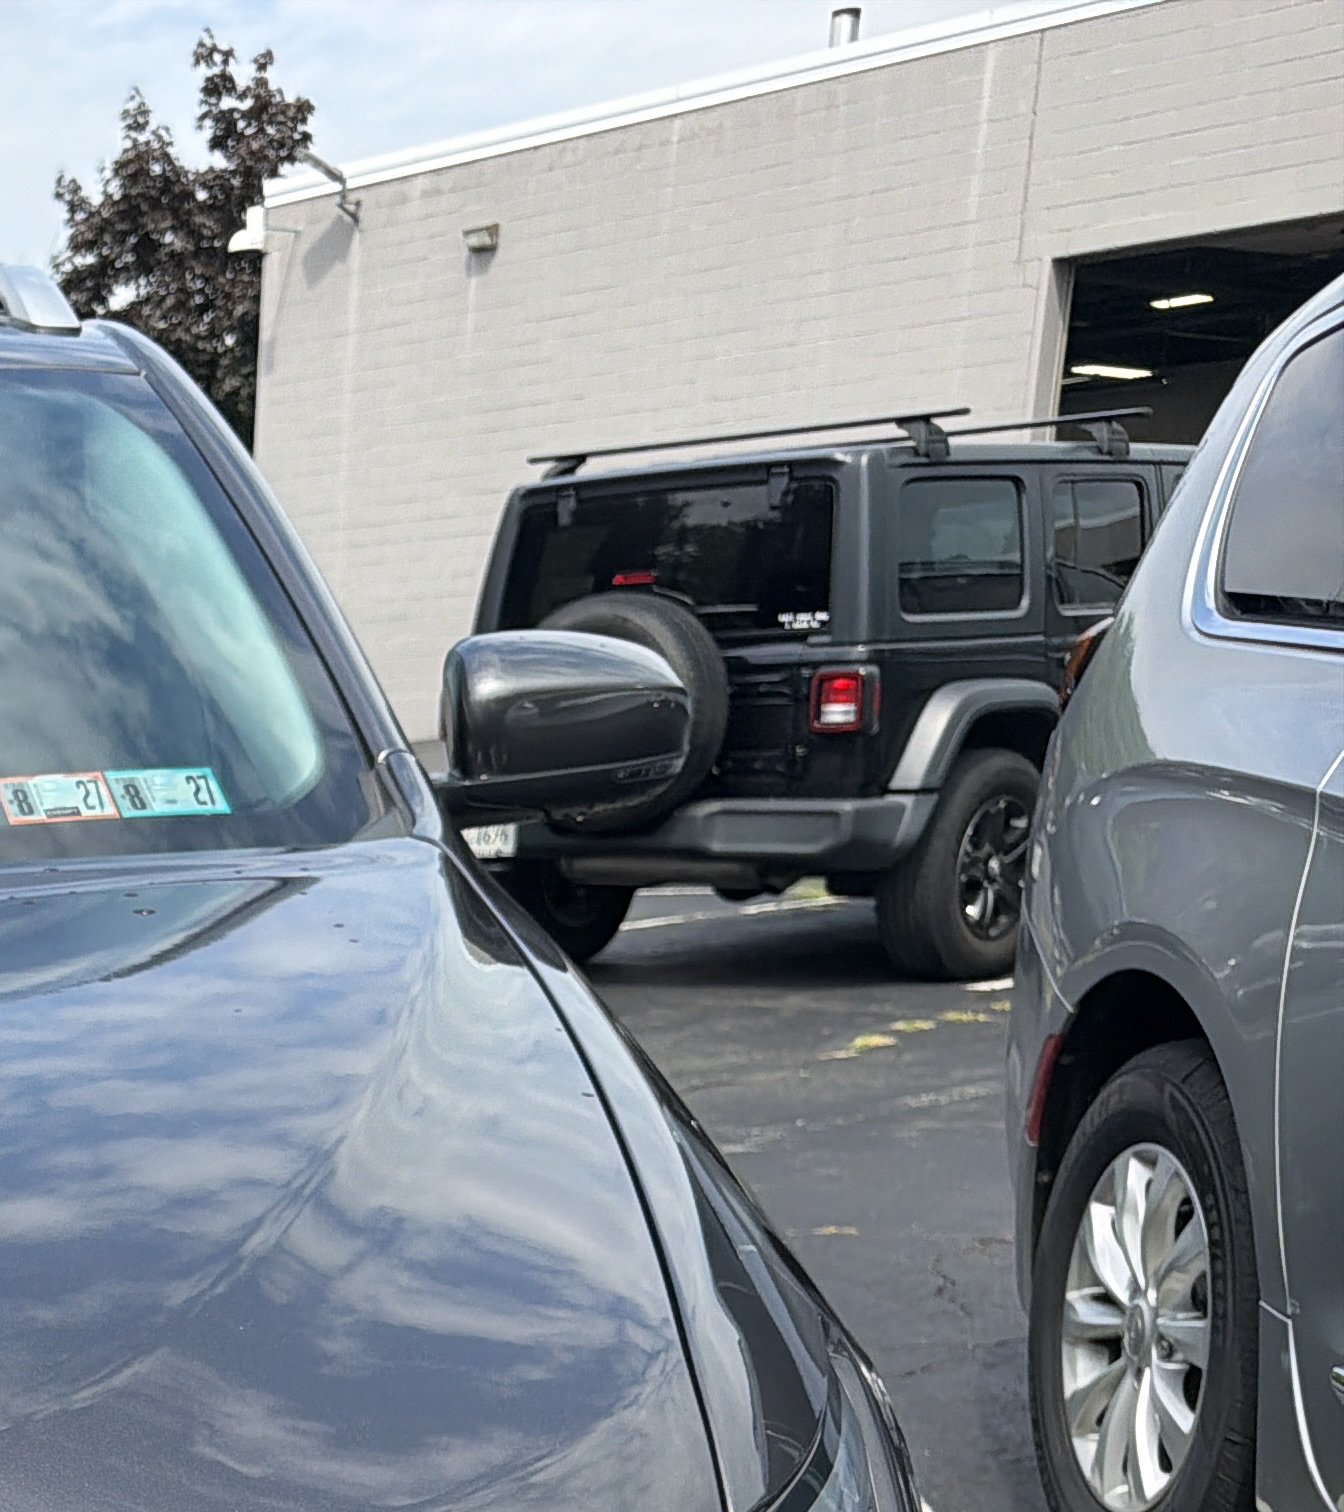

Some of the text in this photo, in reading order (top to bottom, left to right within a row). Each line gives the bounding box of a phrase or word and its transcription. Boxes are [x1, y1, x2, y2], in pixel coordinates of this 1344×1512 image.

[12, 788, 34, 816] 8
[75, 779, 105, 813] 27
[123, 774, 216, 811] 8 27
